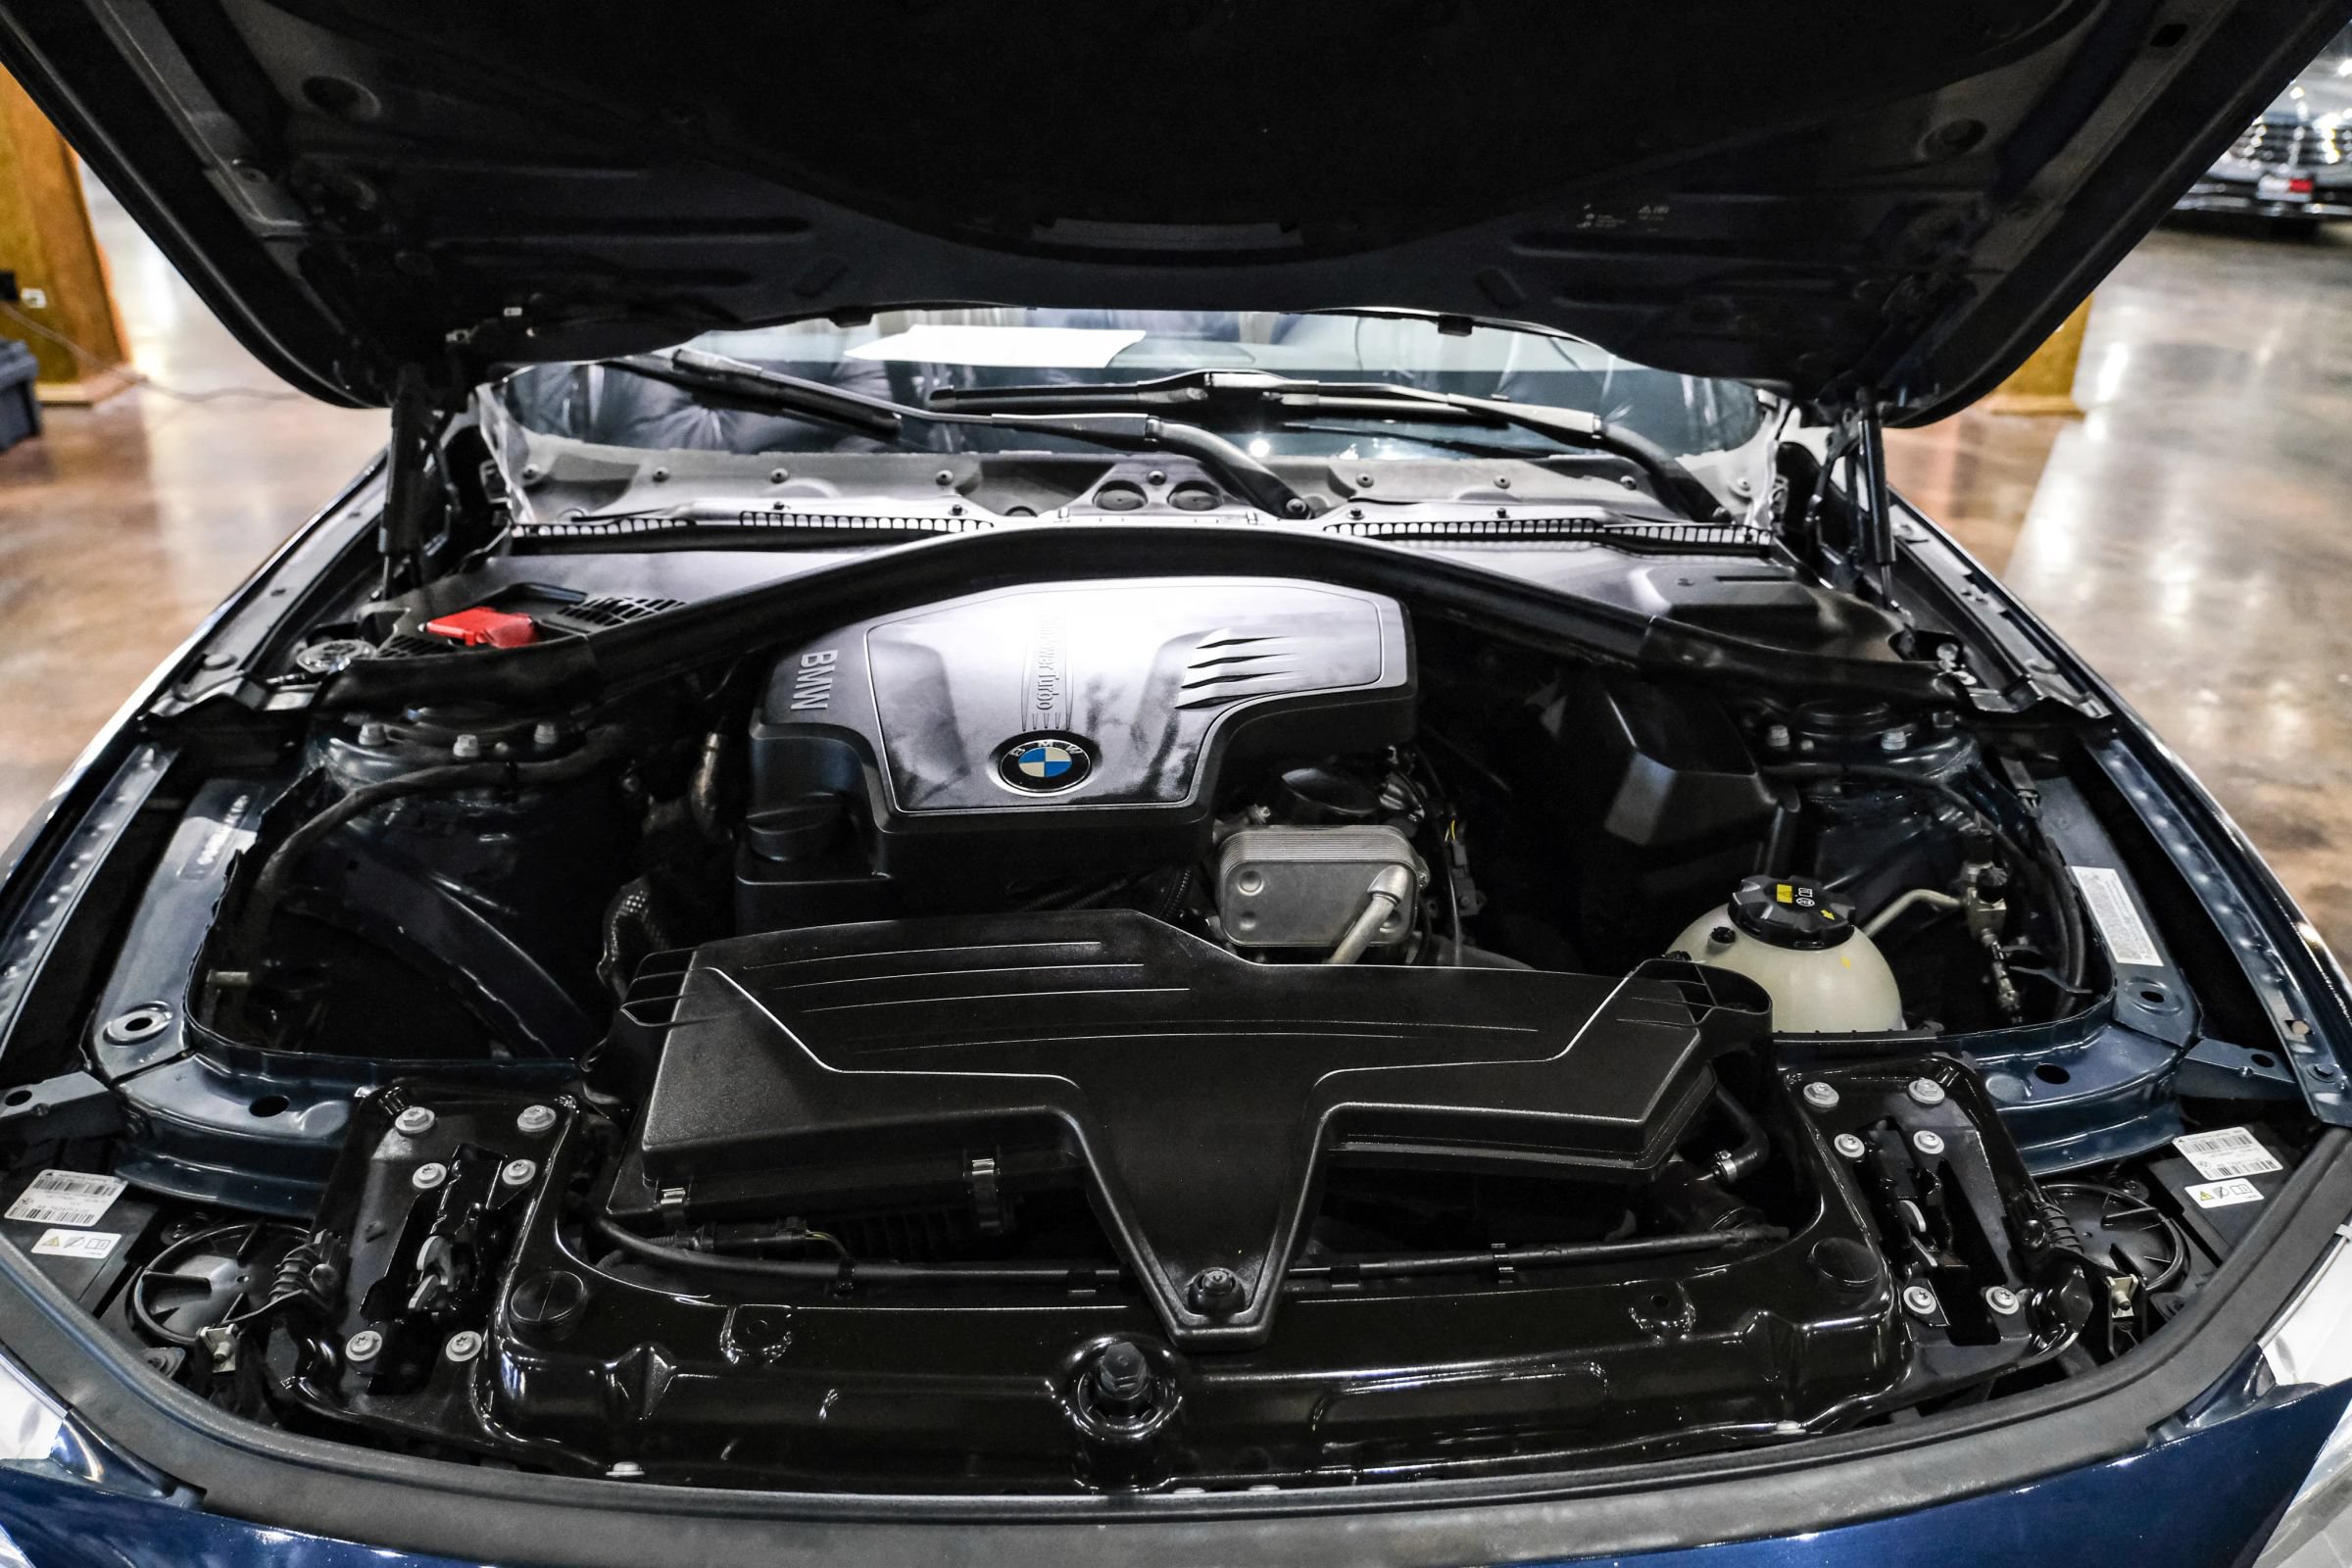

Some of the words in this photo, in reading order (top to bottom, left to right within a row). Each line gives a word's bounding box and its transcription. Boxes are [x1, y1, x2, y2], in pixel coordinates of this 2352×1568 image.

[1038, 613, 1060, 669] inPower
[790, 649, 839, 710] BMW
[1036, 673, 1060, 710] Turbo
[1008, 741, 1083, 758] BMW
